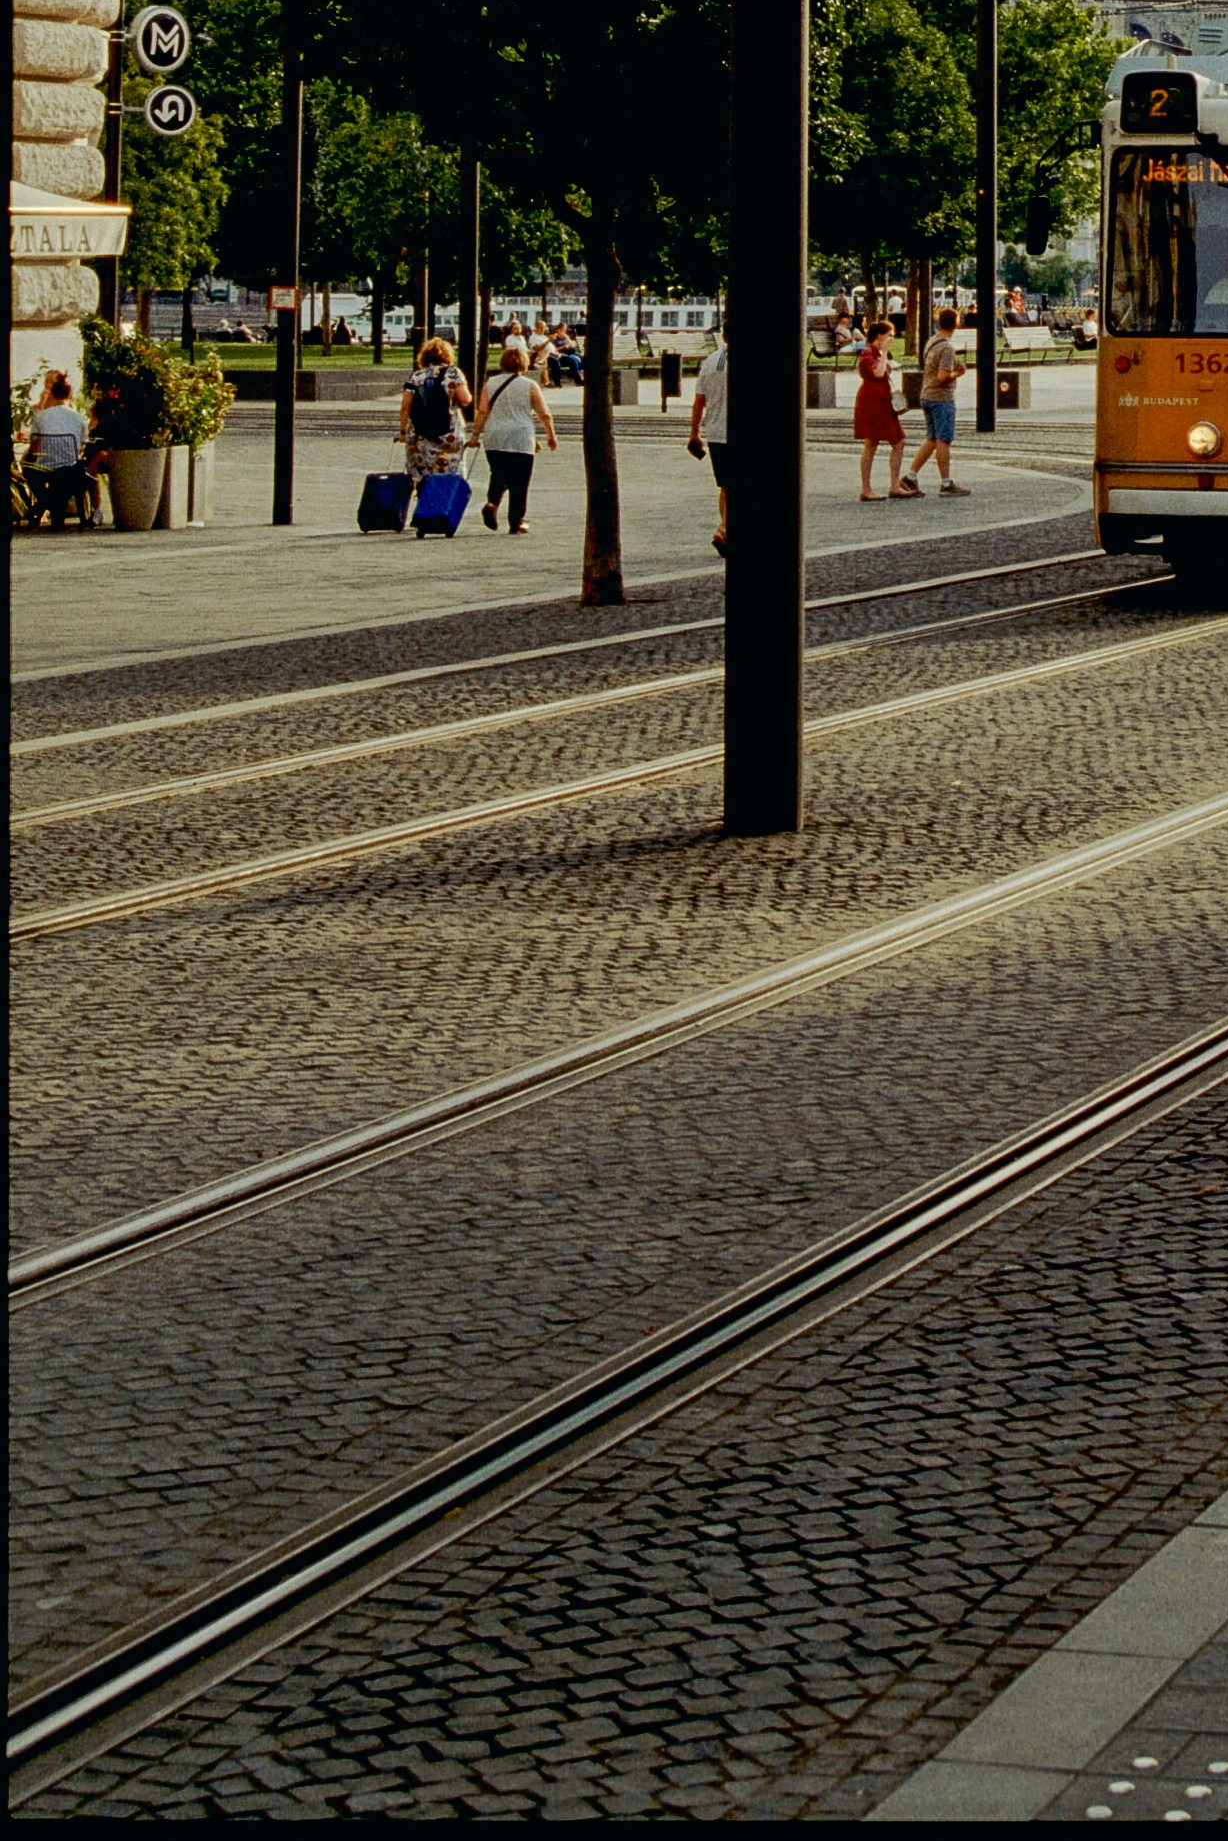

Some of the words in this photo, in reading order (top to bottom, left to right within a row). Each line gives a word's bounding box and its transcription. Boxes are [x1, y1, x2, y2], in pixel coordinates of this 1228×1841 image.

[1149, 89, 1169, 117] 2
[1142, 158, 1204, 183] Jászai
[1143, 397, 1200, 406] BUDAPEST
